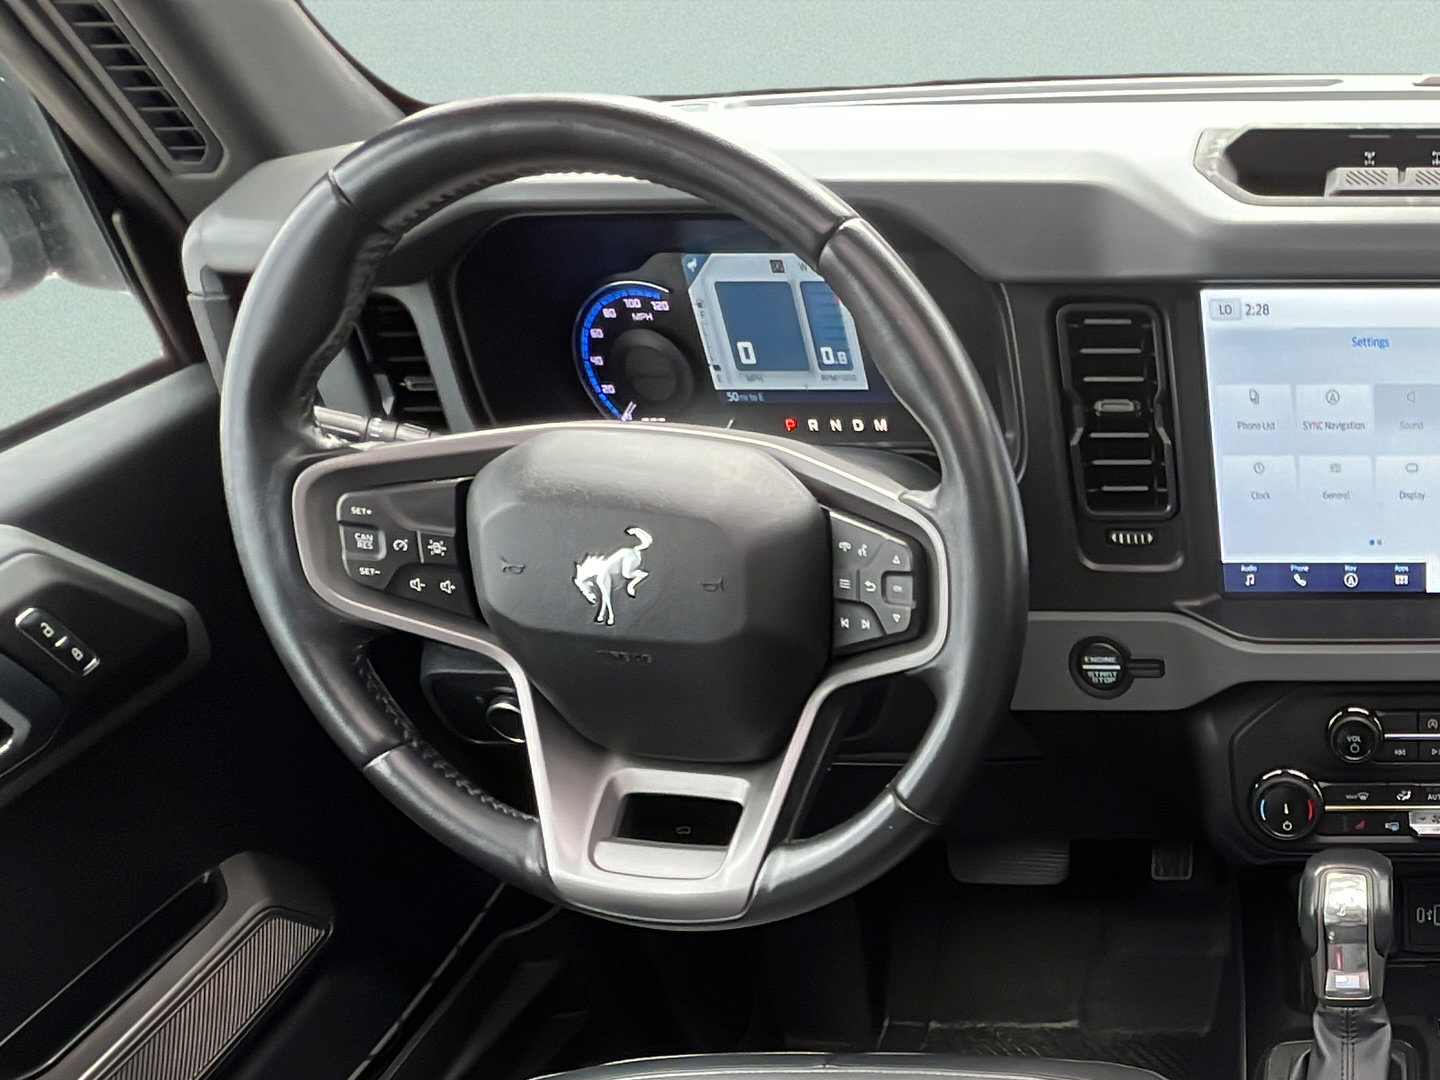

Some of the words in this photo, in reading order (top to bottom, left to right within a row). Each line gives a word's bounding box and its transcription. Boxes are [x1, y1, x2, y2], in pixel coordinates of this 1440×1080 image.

[623, 298, 641, 308] 100
[651, 301, 670, 311] 120
[1219, 304, 1233, 315] LO
[1245, 304, 1270, 316] 2:28
[632, 312, 653, 321] MPH
[1351, 336, 1390, 348] Settings
[737, 341, 756, 365] 0
[820, 346, 848, 365] 0.8
[726, 392, 739, 401] 50
[785, 417, 797, 432] P
[808, 418, 819, 432] R
[830, 418, 842, 432] N
[852, 418, 865, 432] D
[874, 418, 888, 432] M
[1237, 421, 1260, 431] Phone
[1262, 421, 1275, 430] List
[1303, 421, 1323, 431] SYNC
[1325, 421, 1365, 432] Navigation
[1400, 421, 1424, 430] Sound
[1251, 491, 1271, 500] Clock
[1323, 491, 1350, 500] General
[1399, 491, 1425, 501] Display
[351, 506, 373, 515] SET+
[1290, 564, 1309, 572] Phone
[1346, 735, 1362, 743] VOL
